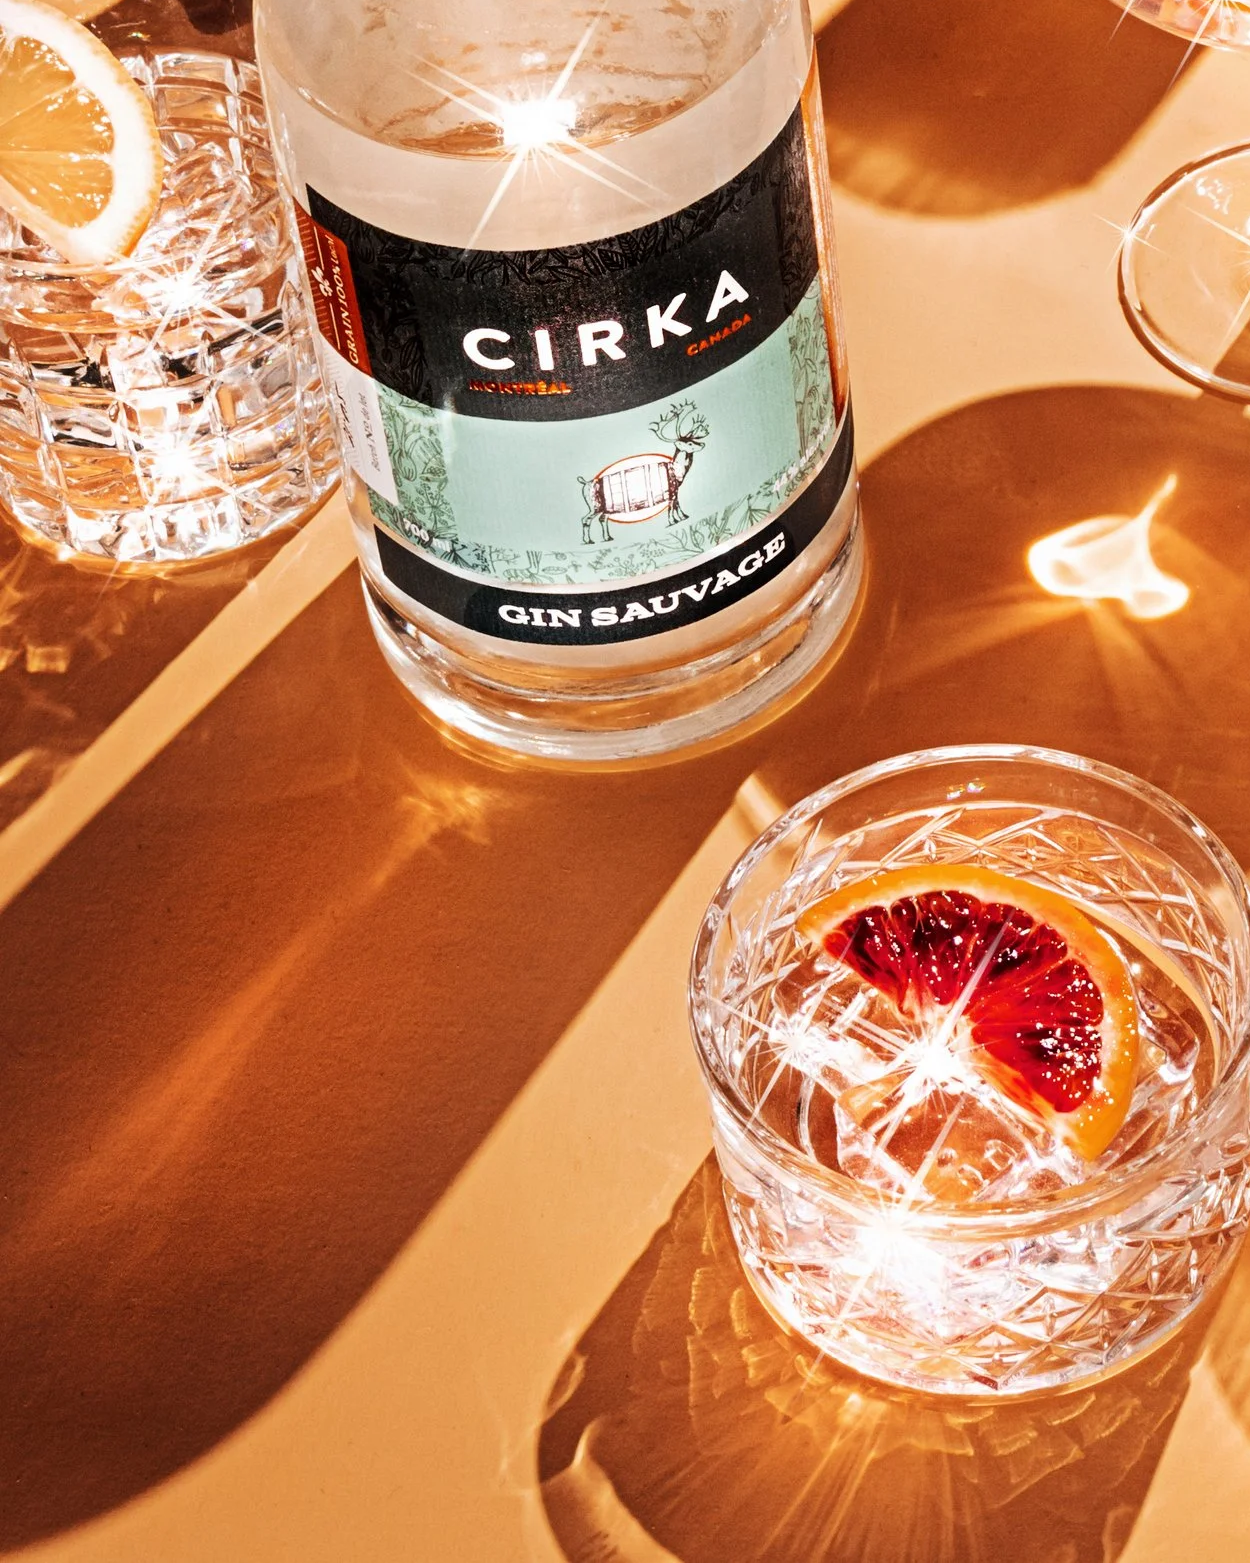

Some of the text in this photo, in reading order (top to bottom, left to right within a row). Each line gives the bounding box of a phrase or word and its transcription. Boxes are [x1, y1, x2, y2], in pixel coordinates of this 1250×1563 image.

[340, 307, 359, 366] GRAIN
[463, 270, 749, 371] CIRKA
[686, 313, 752, 357] CANADA
[498, 532, 786, 628] GIN SAUVAGE
